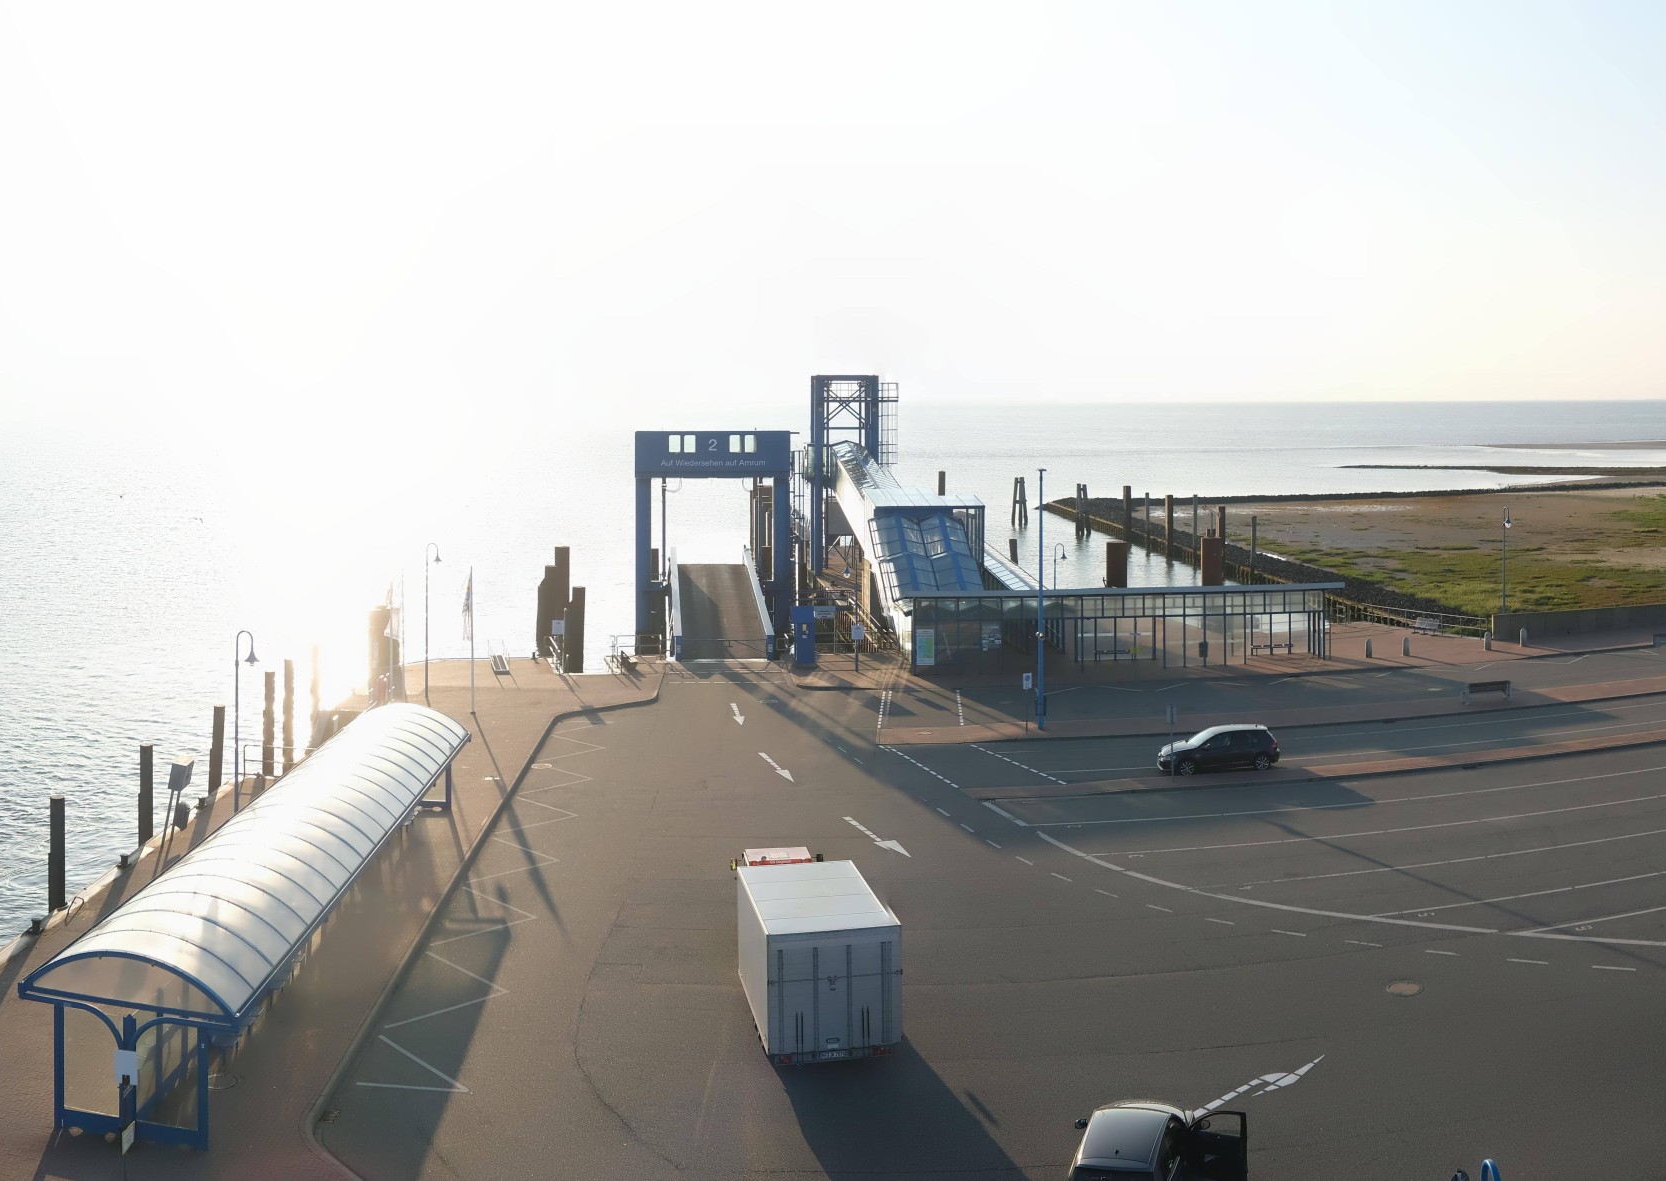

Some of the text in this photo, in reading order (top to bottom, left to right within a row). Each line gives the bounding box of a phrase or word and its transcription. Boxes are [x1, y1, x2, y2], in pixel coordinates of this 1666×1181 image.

[708, 438, 717, 451] 2
[660, 459, 766, 467] Auf Wiedersehen auf Amrum
